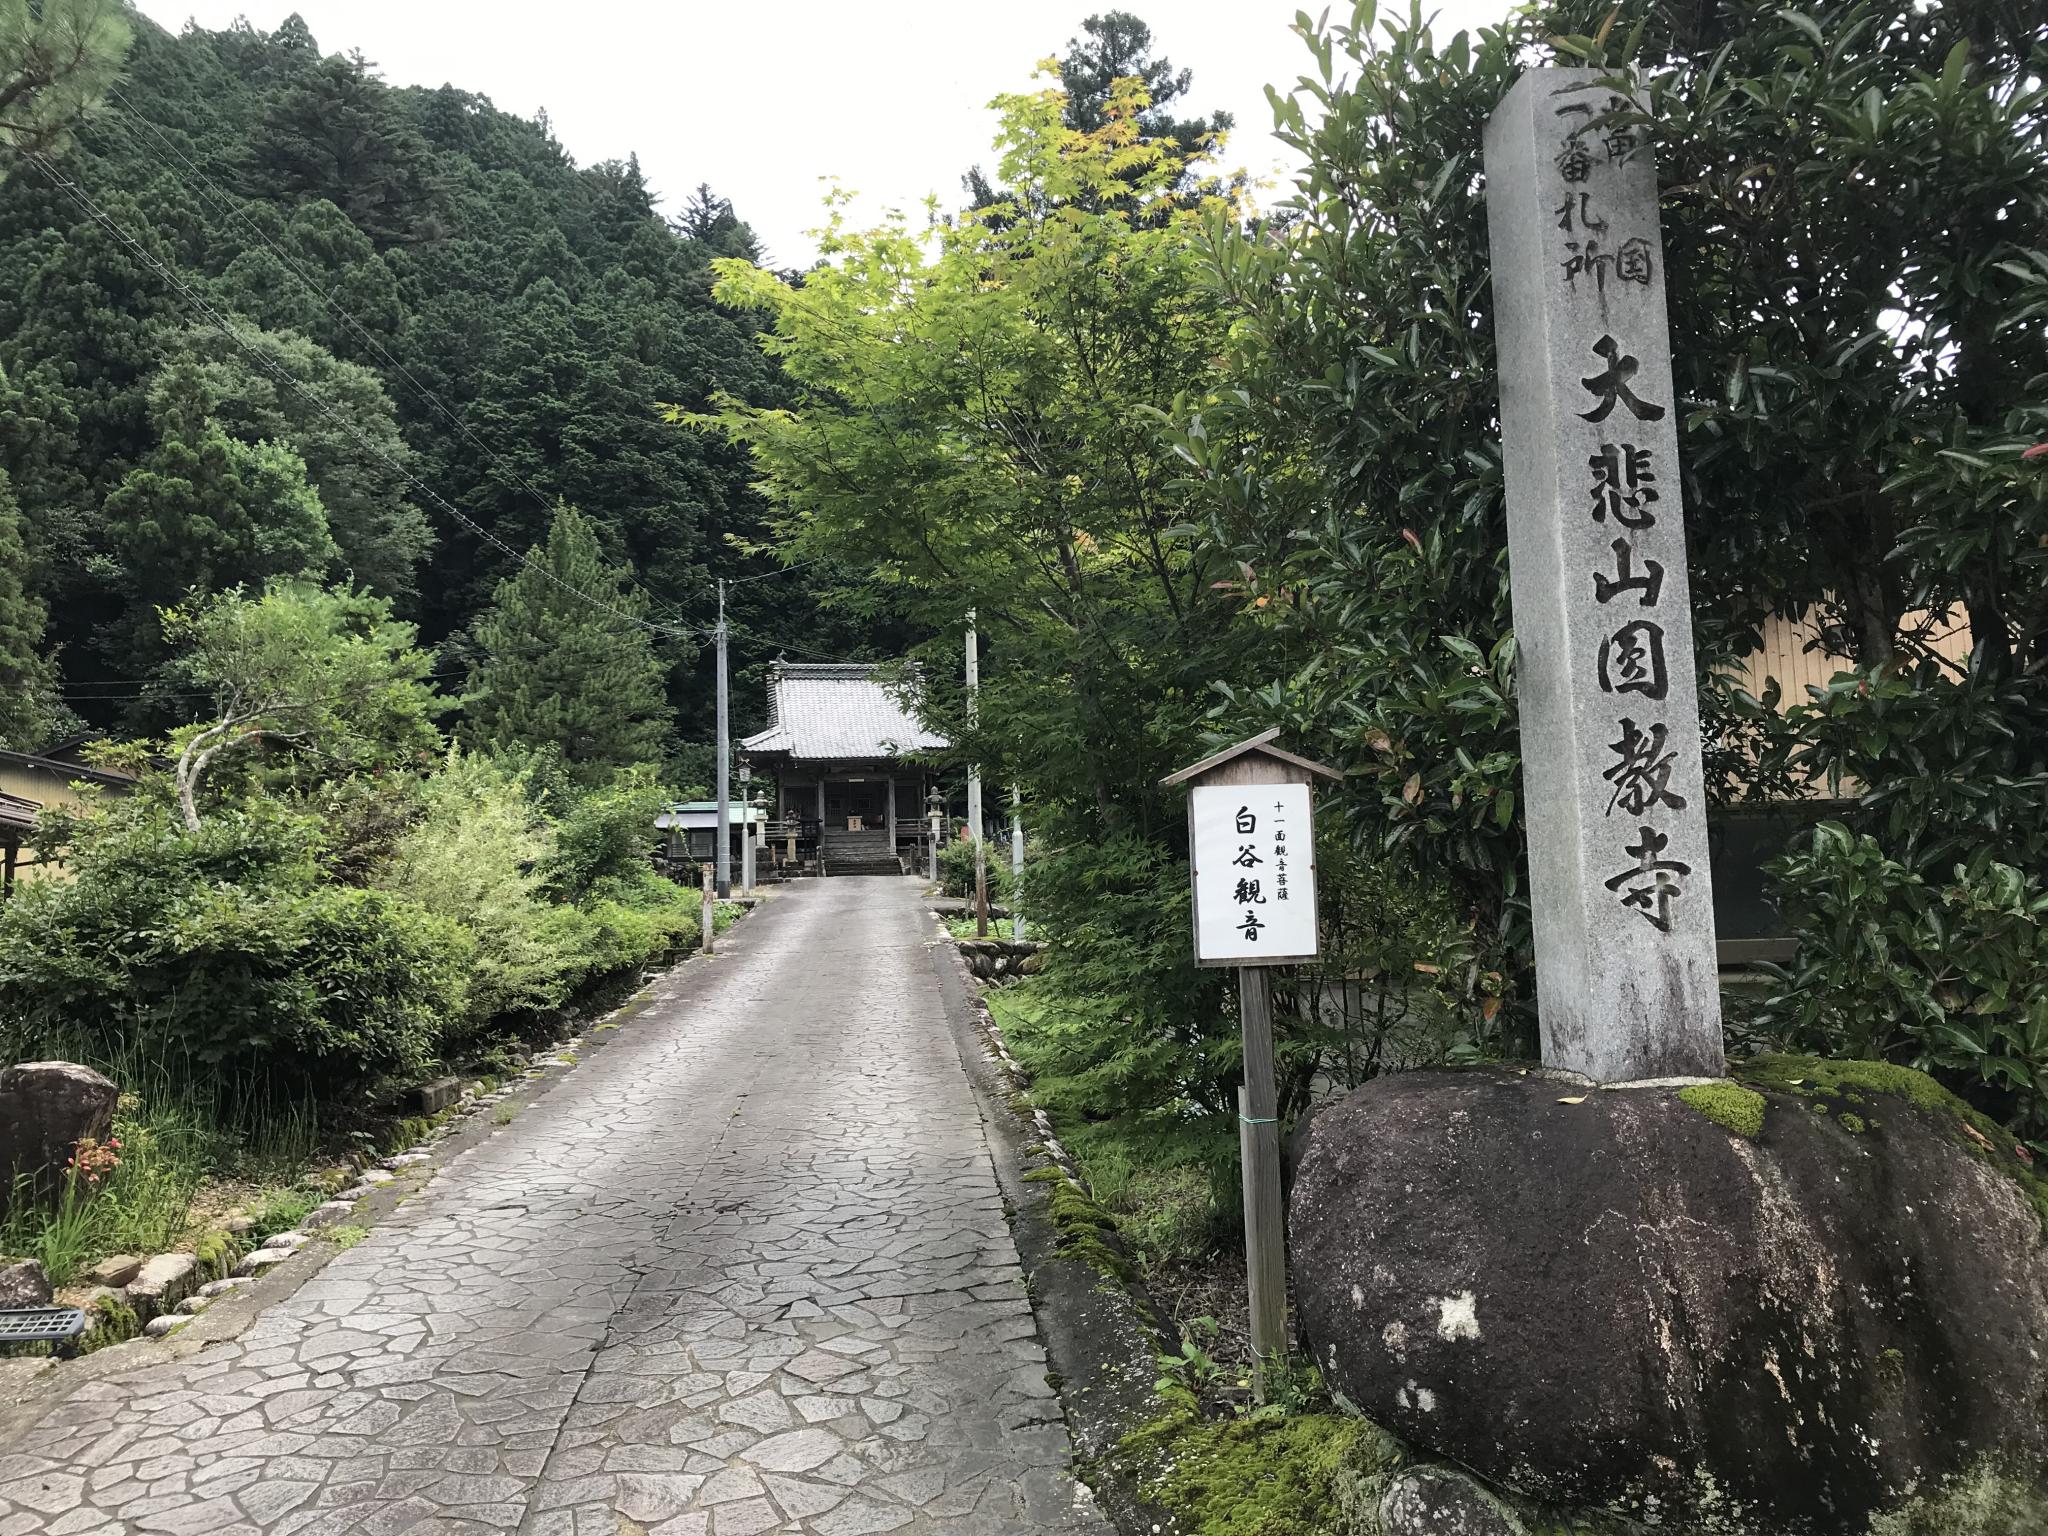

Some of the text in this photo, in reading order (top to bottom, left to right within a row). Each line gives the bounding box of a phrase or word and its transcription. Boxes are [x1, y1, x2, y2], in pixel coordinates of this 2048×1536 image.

[1553, 103, 1615, 303] 一番札所
[1233, 806, 1267, 941] 白谷観音
[1274, 801, 1288, 900] 十一面観音菩薩
